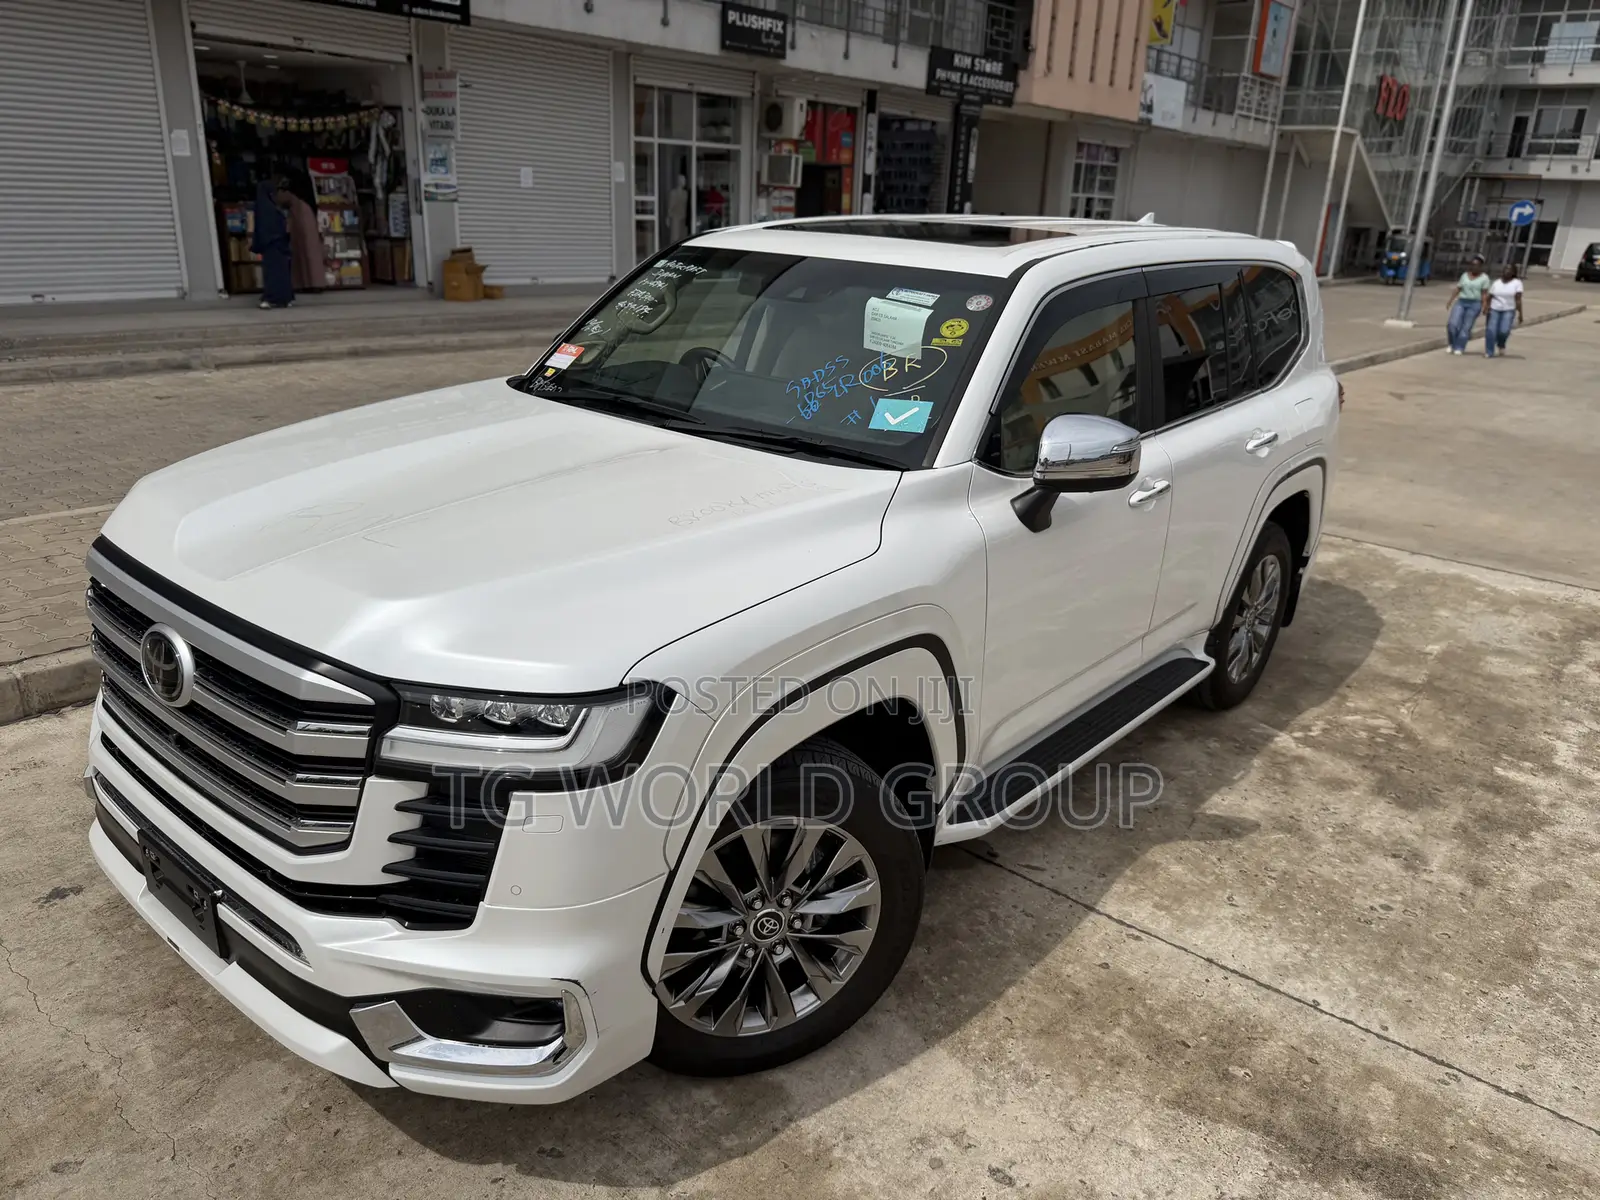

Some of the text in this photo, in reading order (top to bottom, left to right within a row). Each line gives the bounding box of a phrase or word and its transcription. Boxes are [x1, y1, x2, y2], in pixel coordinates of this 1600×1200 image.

[728, 9, 784, 34] PLUSHFIX
[953, 52, 972, 70] KIM
[968, 74, 1014, 93] ACCESSORIES
[429, 120, 455, 130] VITABU
